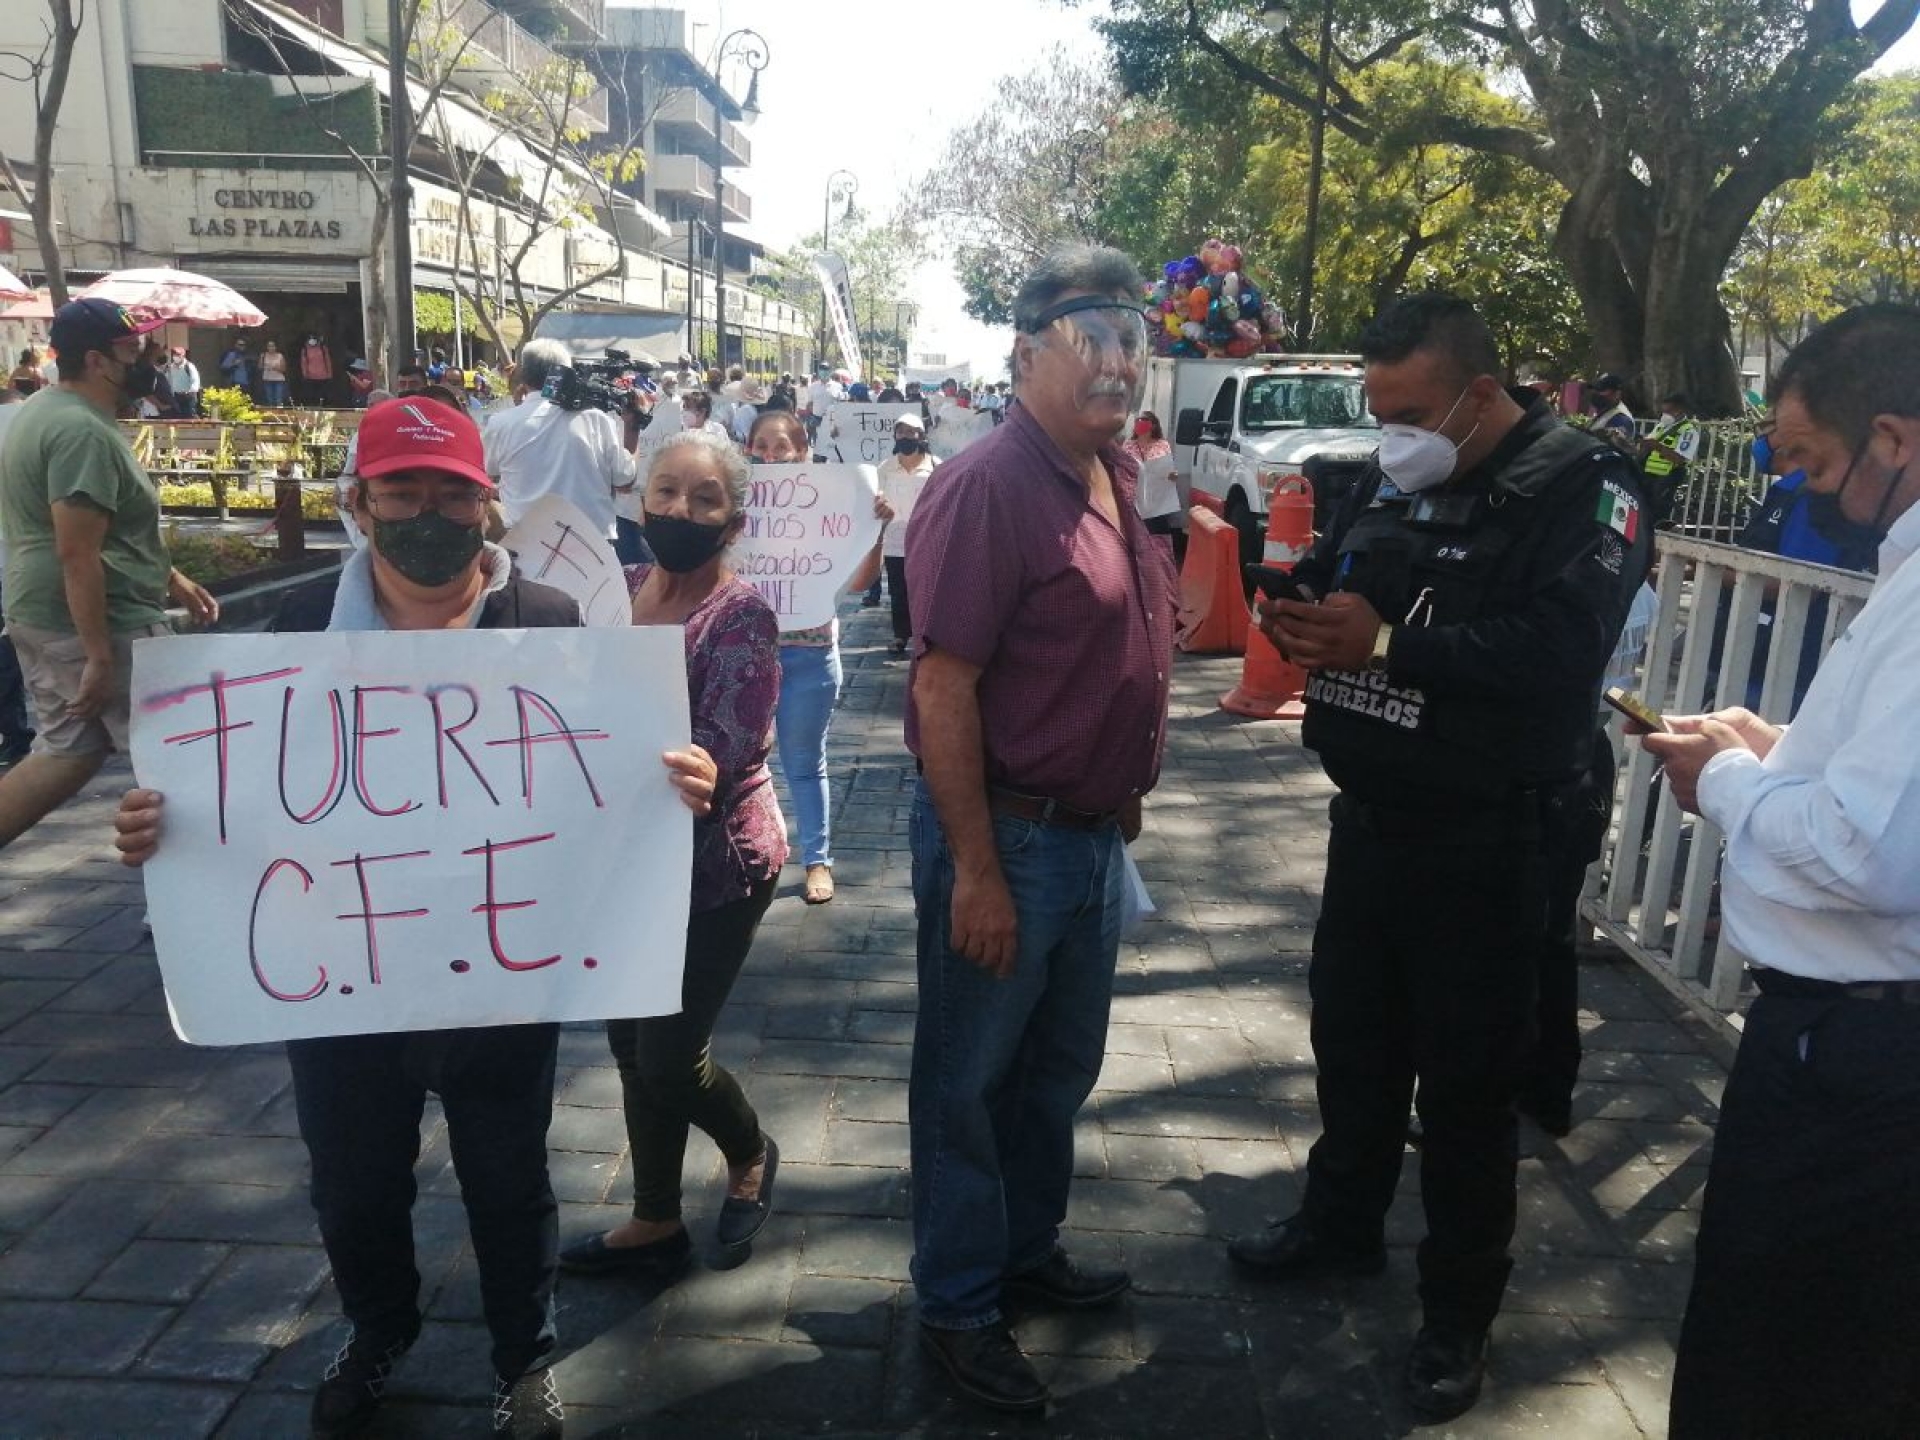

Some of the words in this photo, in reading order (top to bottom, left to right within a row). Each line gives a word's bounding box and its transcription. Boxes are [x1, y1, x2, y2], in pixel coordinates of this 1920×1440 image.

[214, 189, 316, 210] CENTRO
[188, 217, 237, 238] LAS
[243, 219, 341, 239] PLAZAS
[742, 473, 819, 510] omos
[743, 511, 806, 540] arios
[821, 511, 851, 539] NO
[1306, 676, 1421, 729] MORELOS
[141, 667, 611, 845] FUERA
